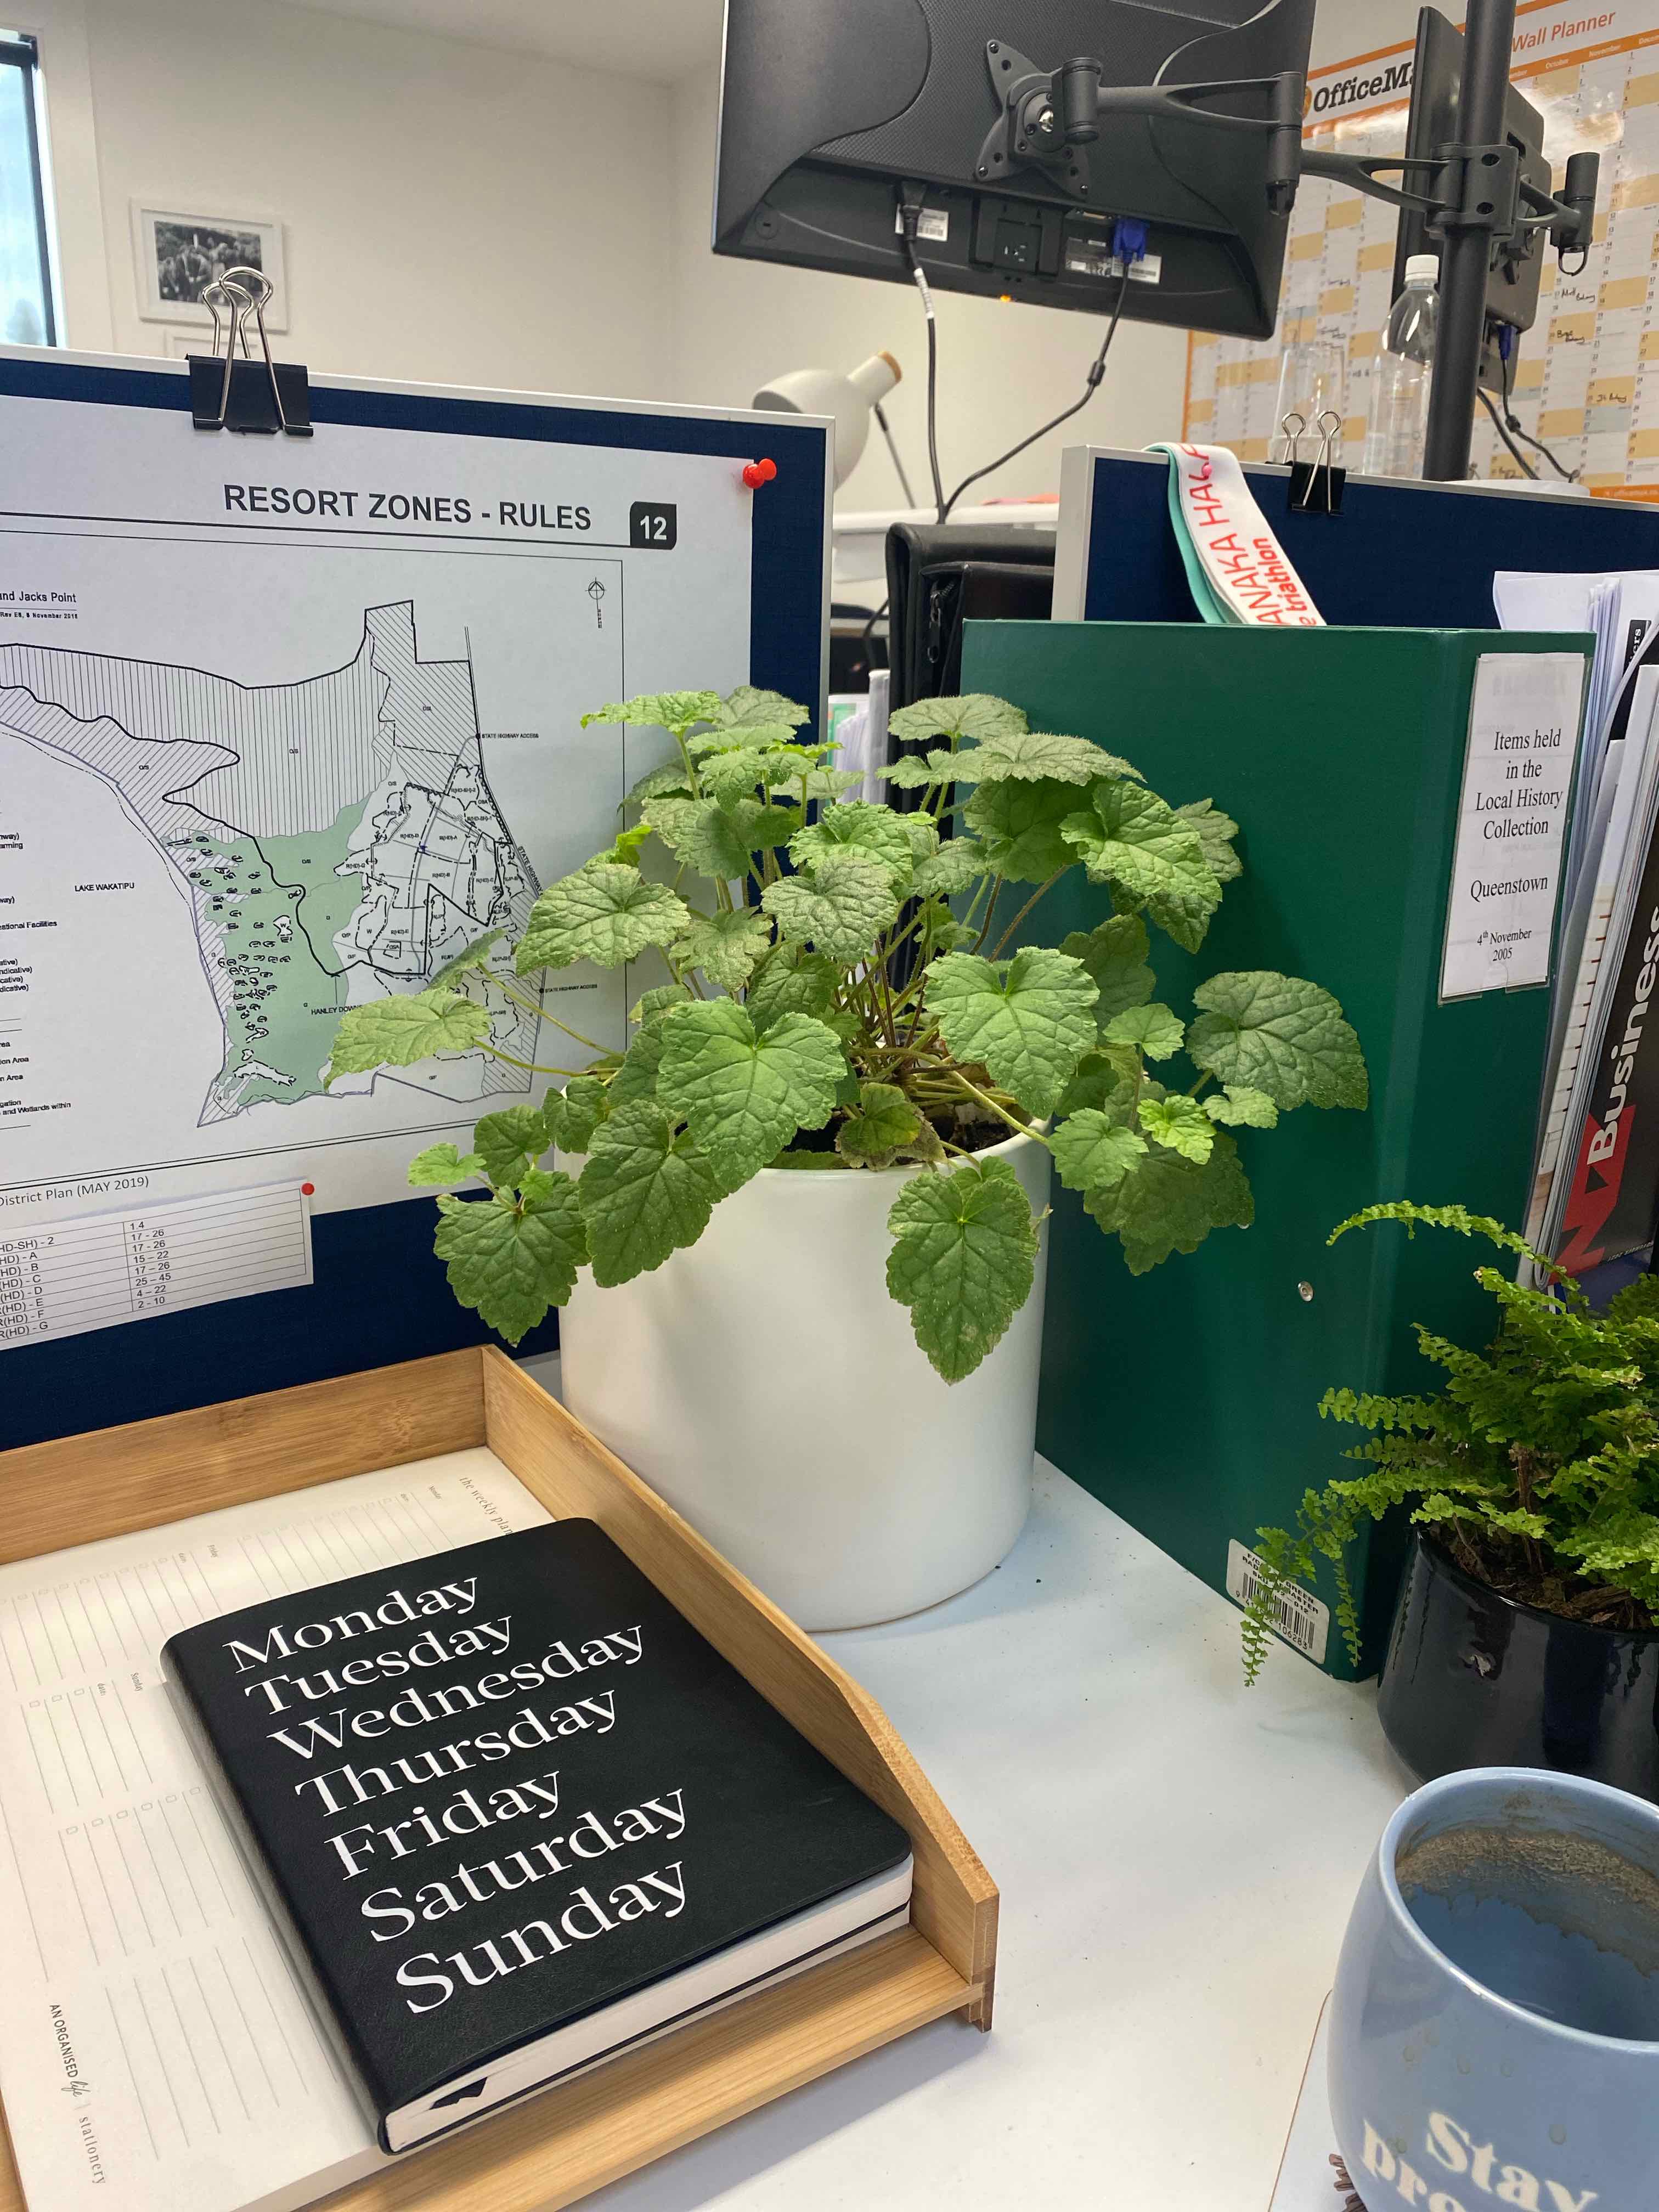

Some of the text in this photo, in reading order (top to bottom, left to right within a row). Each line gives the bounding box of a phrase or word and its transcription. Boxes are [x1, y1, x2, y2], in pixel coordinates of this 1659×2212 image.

[1511, 12, 1616, 52] Wall Planner
[1313, 62, 1414, 112] OfficeM
[224, 484, 358, 517] RESORT
[369, 494, 471, 523] ZONES
[500, 501, 591, 530] RULES
[640, 515, 667, 541] 12
[1252, 538, 1307, 612] triathlon
[19, 591, 47, 601] Jacks
[51, 592, 76, 602] Point
[1493, 729, 1561, 752] Items held
[1505, 759, 1542, 780] in the
[1475, 787, 1563, 811] Local History
[1483, 817, 1549, 840] Collection
[517, 845, 543, 893] STATE HIGHWAY
[96, 882, 134, 890] WAKATIPU
[1470, 877, 1549, 902] Queenstown
[1477, 928, 1532, 946] 4th November
[1492, 948, 1513, 961] 2005
[311, 1007, 337, 1015] HANLEY
[1587, 905, 1659, 1165] Business
[18, 1104, 49, 1114] Wetlands
[51, 1102, 71, 1110] within
[46, 1188, 72, 1200] Plan
[77, 1181, 110, 1197] (MAY
[114, 1176, 149, 1190] 2019)
[48, 1237, 54, 1245] 2
[132, 1229, 165, 1241] 17 26
[132, 1240, 165, 1252] 17 26
[29, 1252, 38, 1260] A
[133, 1250, 169, 1264] 15 22
[32, 1274, 41, 1283] C
[135, 1261, 170, 1275] 17 26
[136, 1272, 171, 1286] 25 45
[34, 1286, 43, 1295] D
[137, 1284, 166, 1297] 4 22
[155, 1296, 165, 1305] 10
[36, 1298, 44, 1307] E
[38, 1310, 45, 1318] F
[39, 1321, 48, 1330] G
[459, 1477, 474, 1489] the
[471, 1489, 498, 1515] weekly
[1285, 1581, 1314, 1604] GREEN
[221, 1576, 478, 1675] Monday
[1277, 1622, 1308, 1650] 106283
[245, 1615, 512, 1716] Tuesday
[267, 1624, 645, 1760] Wednesday
[295, 1689, 617, 1818] Thursday
[324, 1770, 560, 1882] Friday
[360, 1788, 686, 1943] Saturday
[395, 1860, 686, 2015] Sunday
[49, 2004, 106, 2184] AN ORGANISED life stationery
[1426, 2111, 1598, 2212] Stay
